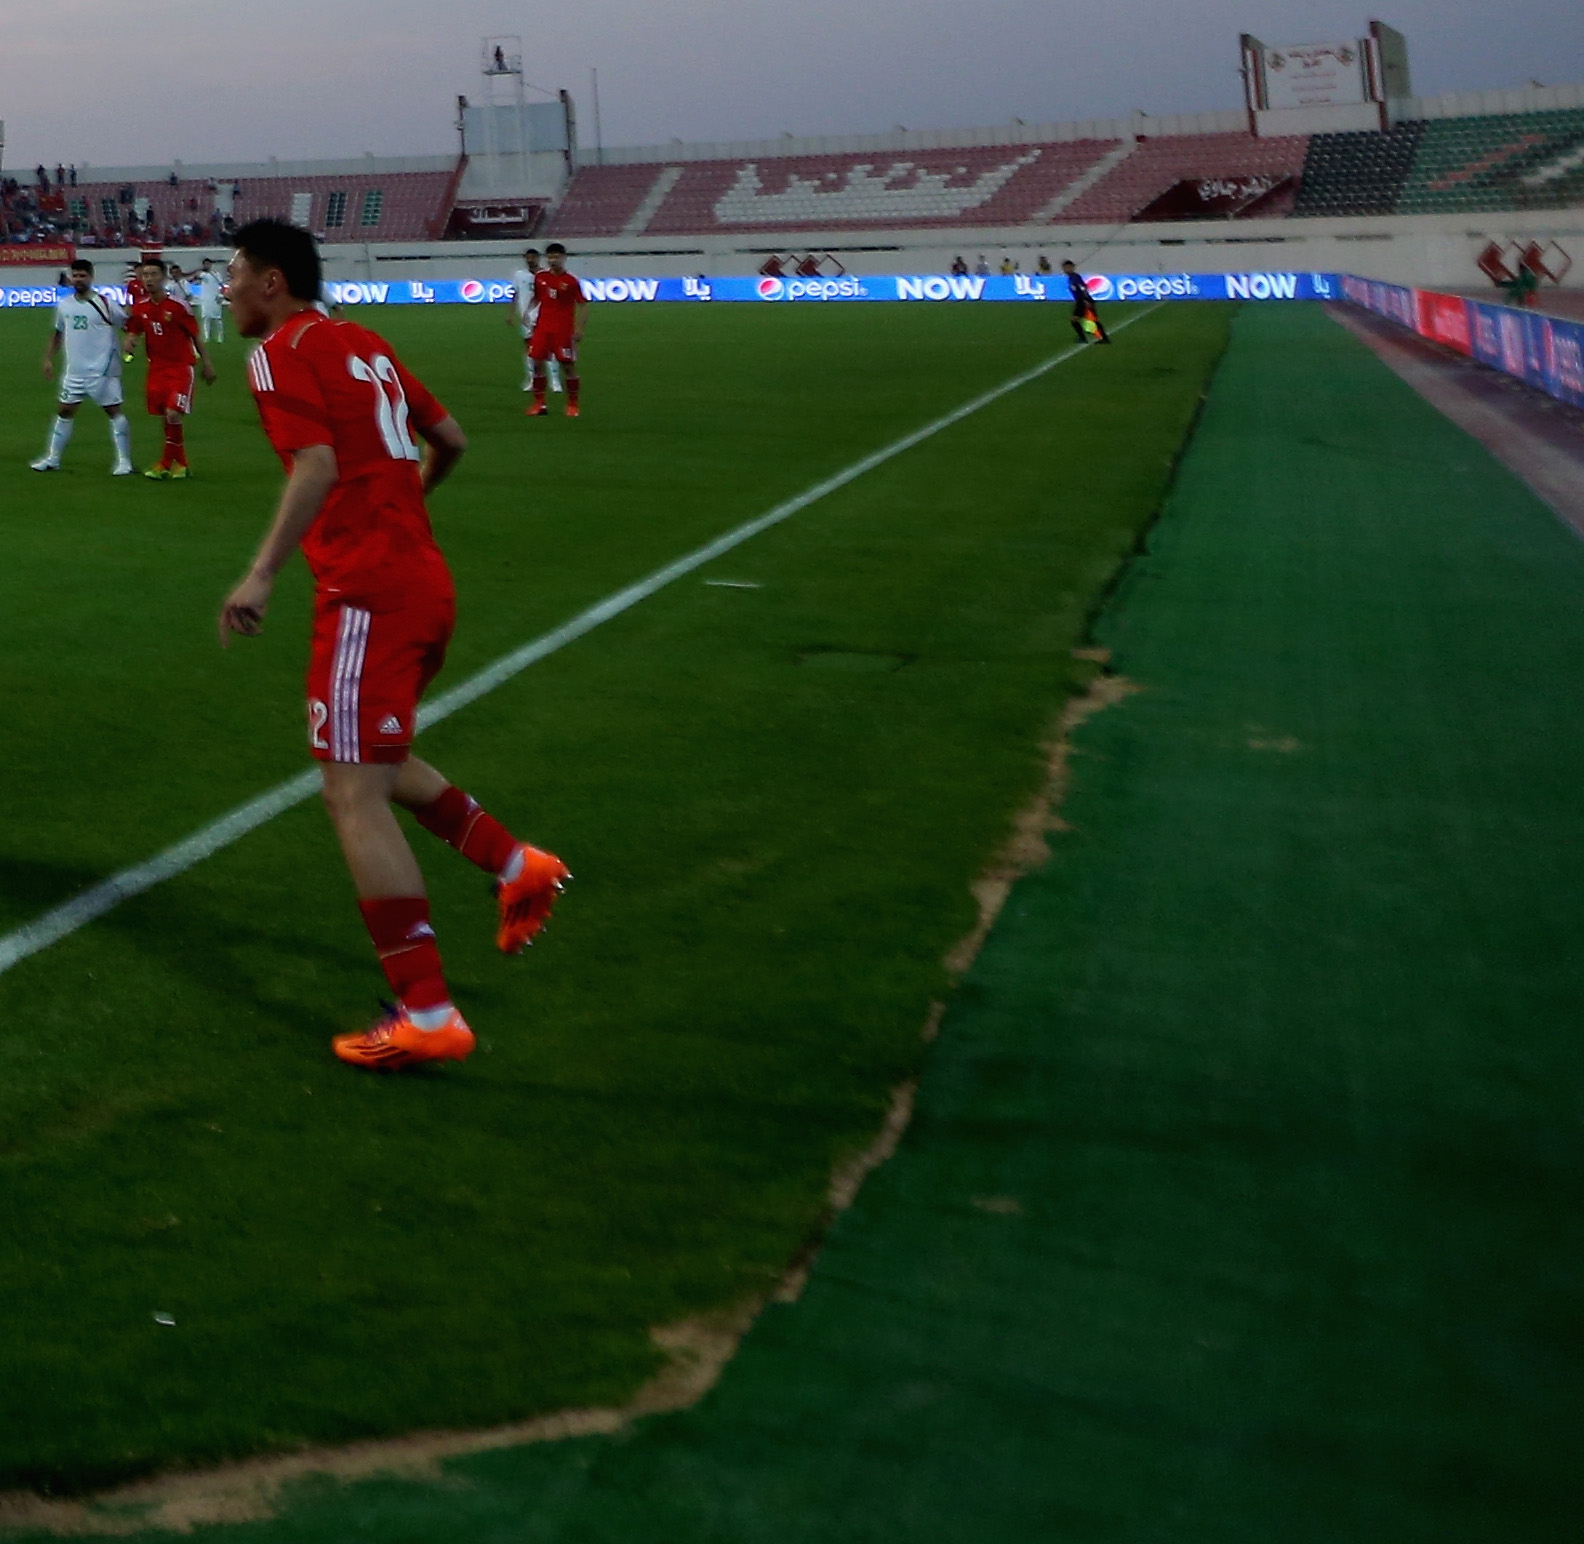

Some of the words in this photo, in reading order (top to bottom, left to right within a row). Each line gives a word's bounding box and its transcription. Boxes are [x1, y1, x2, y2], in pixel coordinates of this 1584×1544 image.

[8, 289, 57, 308] pepsi
[411, 282, 435, 303] يلا
[580, 279, 660, 301] NOW
[682, 275, 712, 301] يلا
[788, 277, 860, 301] pepsi
[896, 277, 986, 301] NOW
[1014, 274, 1046, 300] يلا
[1118, 274, 1190, 300] pepsi
[1225, 275, 1297, 299] NOW
[73, 315, 88, 330] 23
[309, 699, 330, 750] 2
